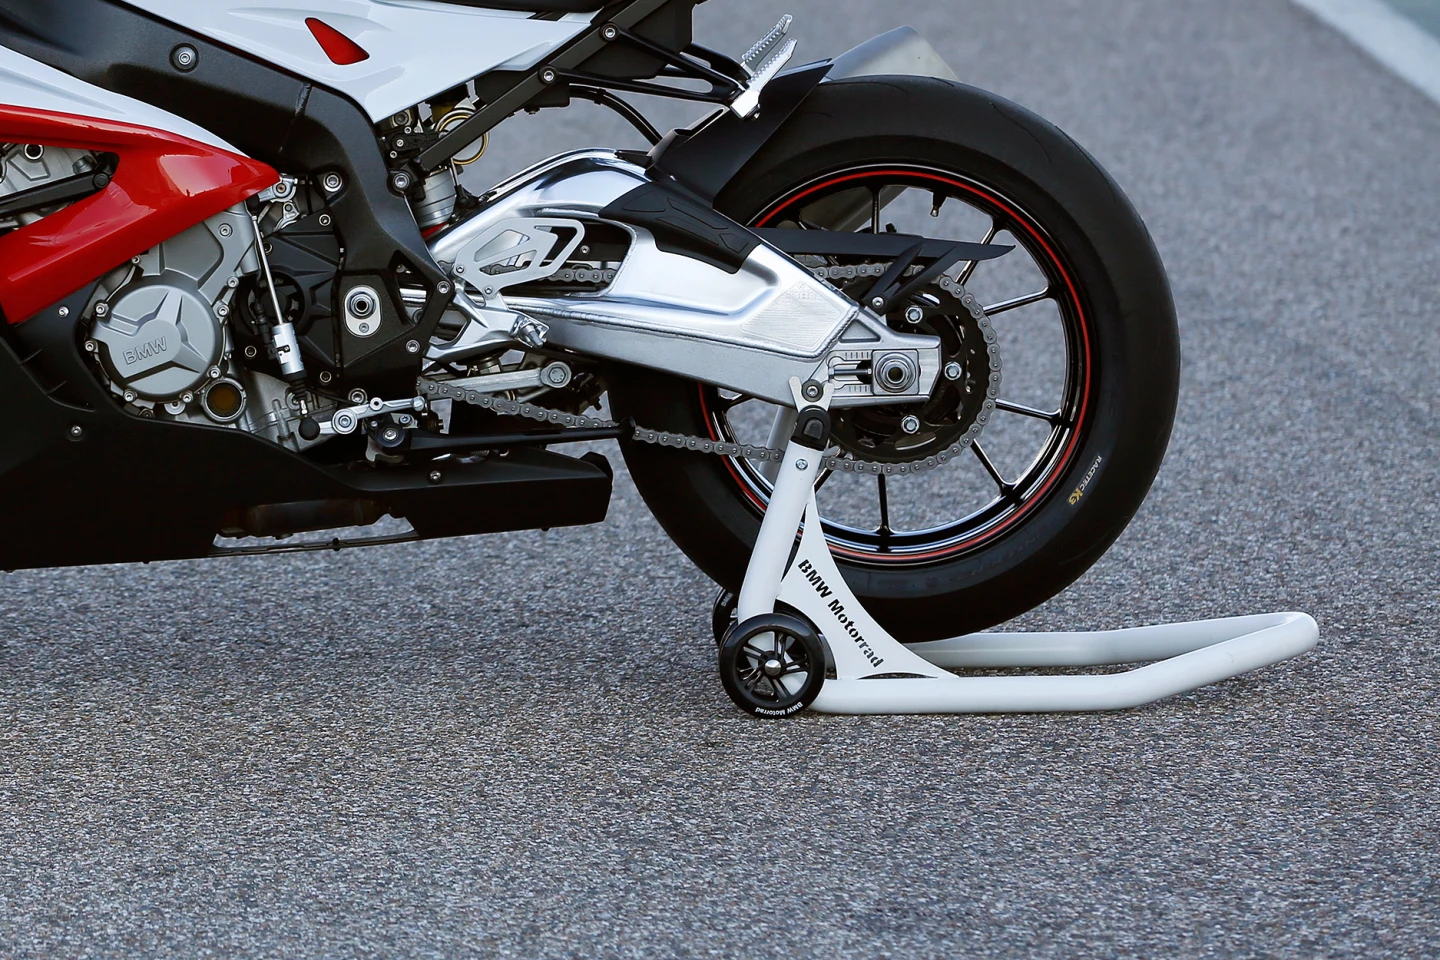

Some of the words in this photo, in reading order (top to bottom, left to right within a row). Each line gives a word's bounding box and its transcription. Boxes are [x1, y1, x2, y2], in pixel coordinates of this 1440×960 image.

[122, 336, 167, 365] BMW
[1068, 488, 1083, 506] K3
[797, 559, 833, 599] BMW
[827, 598, 884, 668] Motorrad
[755, 707, 786, 716] Motorrad
[787, 701, 803, 714] BMW
